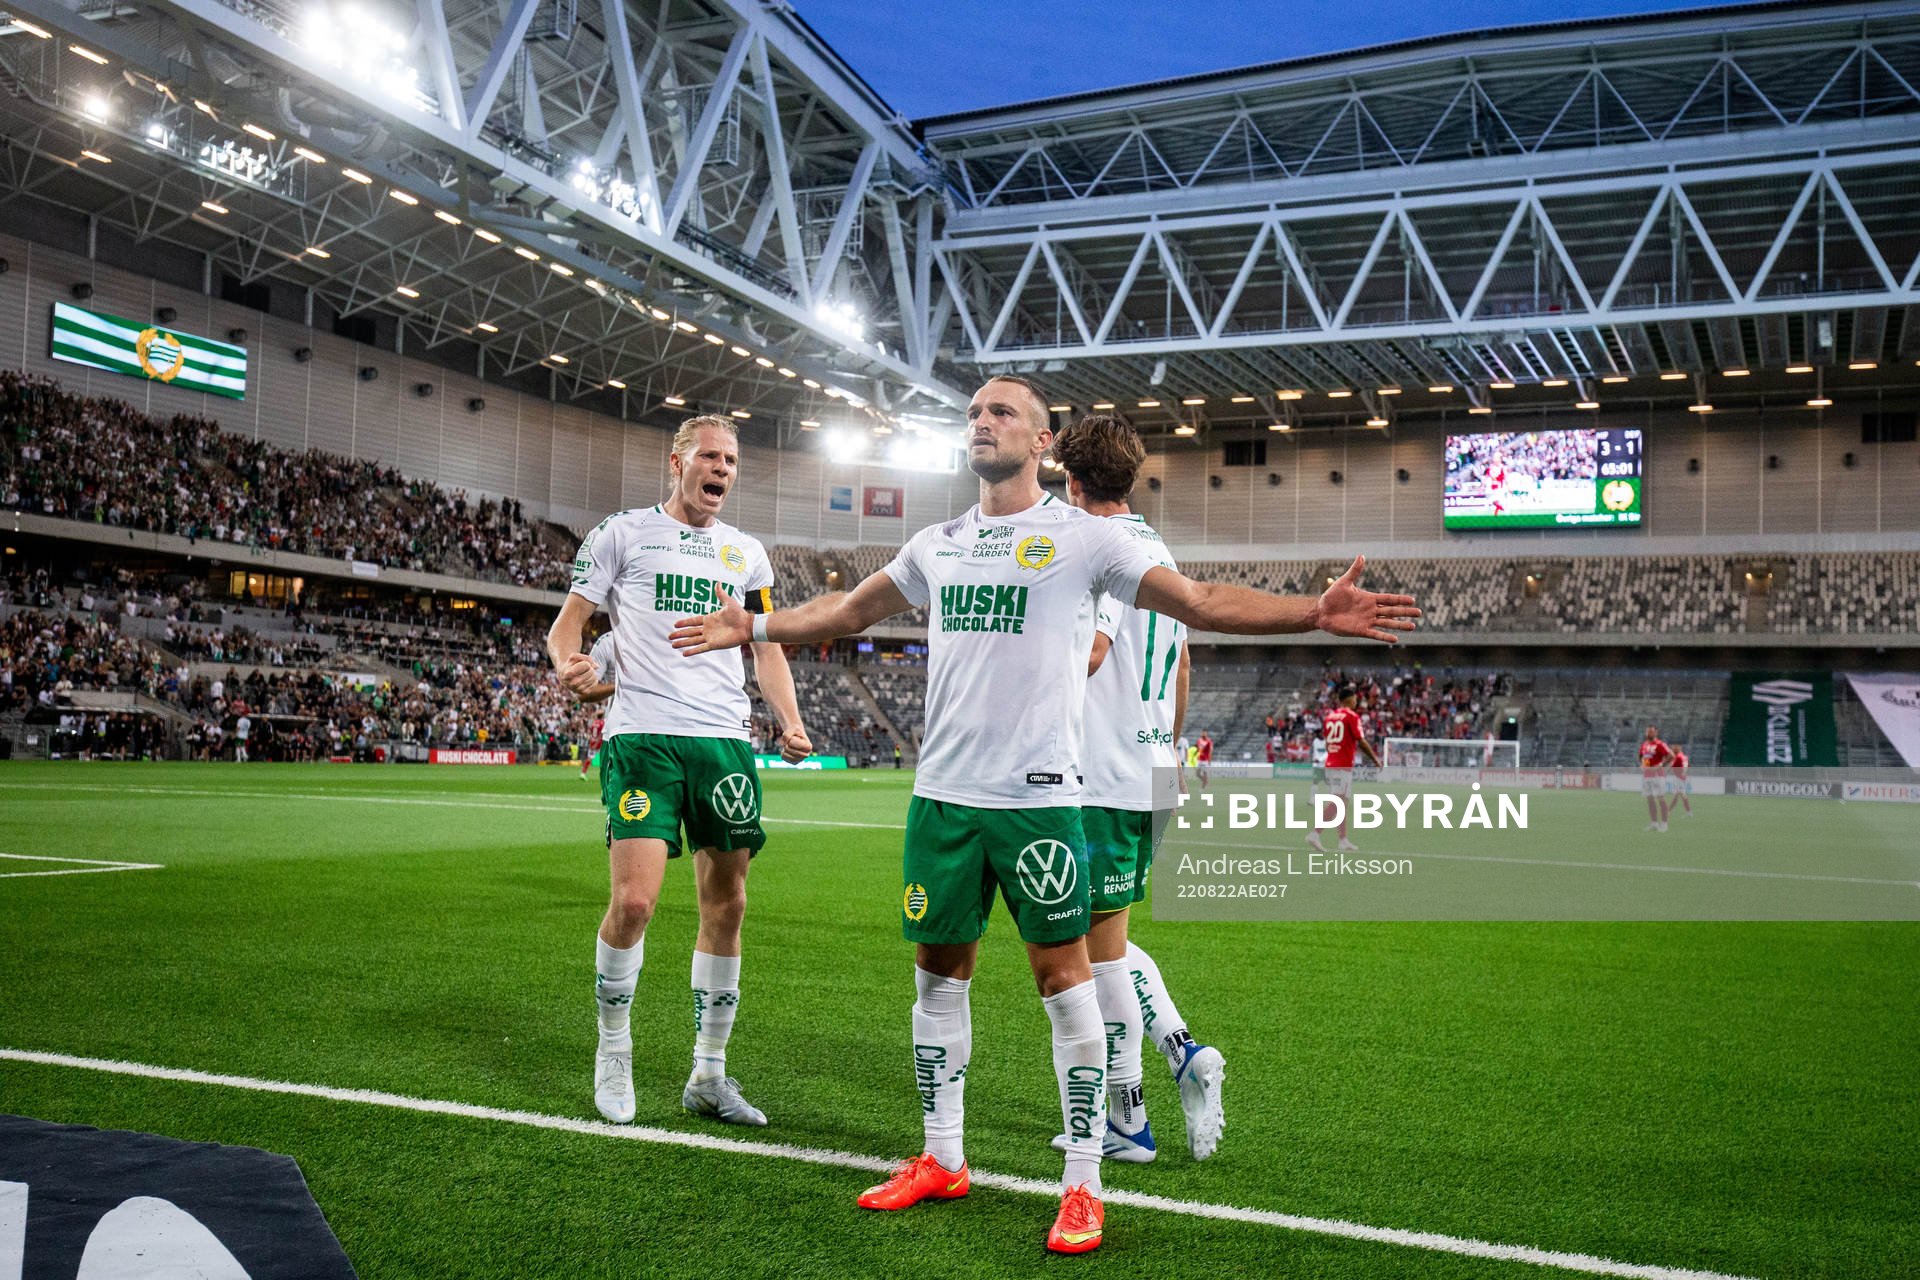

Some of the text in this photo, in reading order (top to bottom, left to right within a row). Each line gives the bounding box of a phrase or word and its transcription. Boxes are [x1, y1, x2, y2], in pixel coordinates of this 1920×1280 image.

[1600, 441, 1610, 456] 3
[1626, 440, 1634, 455] 1
[654, 599, 722, 615] CHOCOLA
[940, 585, 1028, 618] HUSKI
[942, 617, 1024, 635] CHOCOLATE
[1326, 721, 1344, 744] 20
[437, 751, 509, 765] HUSKI CHOCOLATE
[1047, 909, 1077, 921] CRAFT
